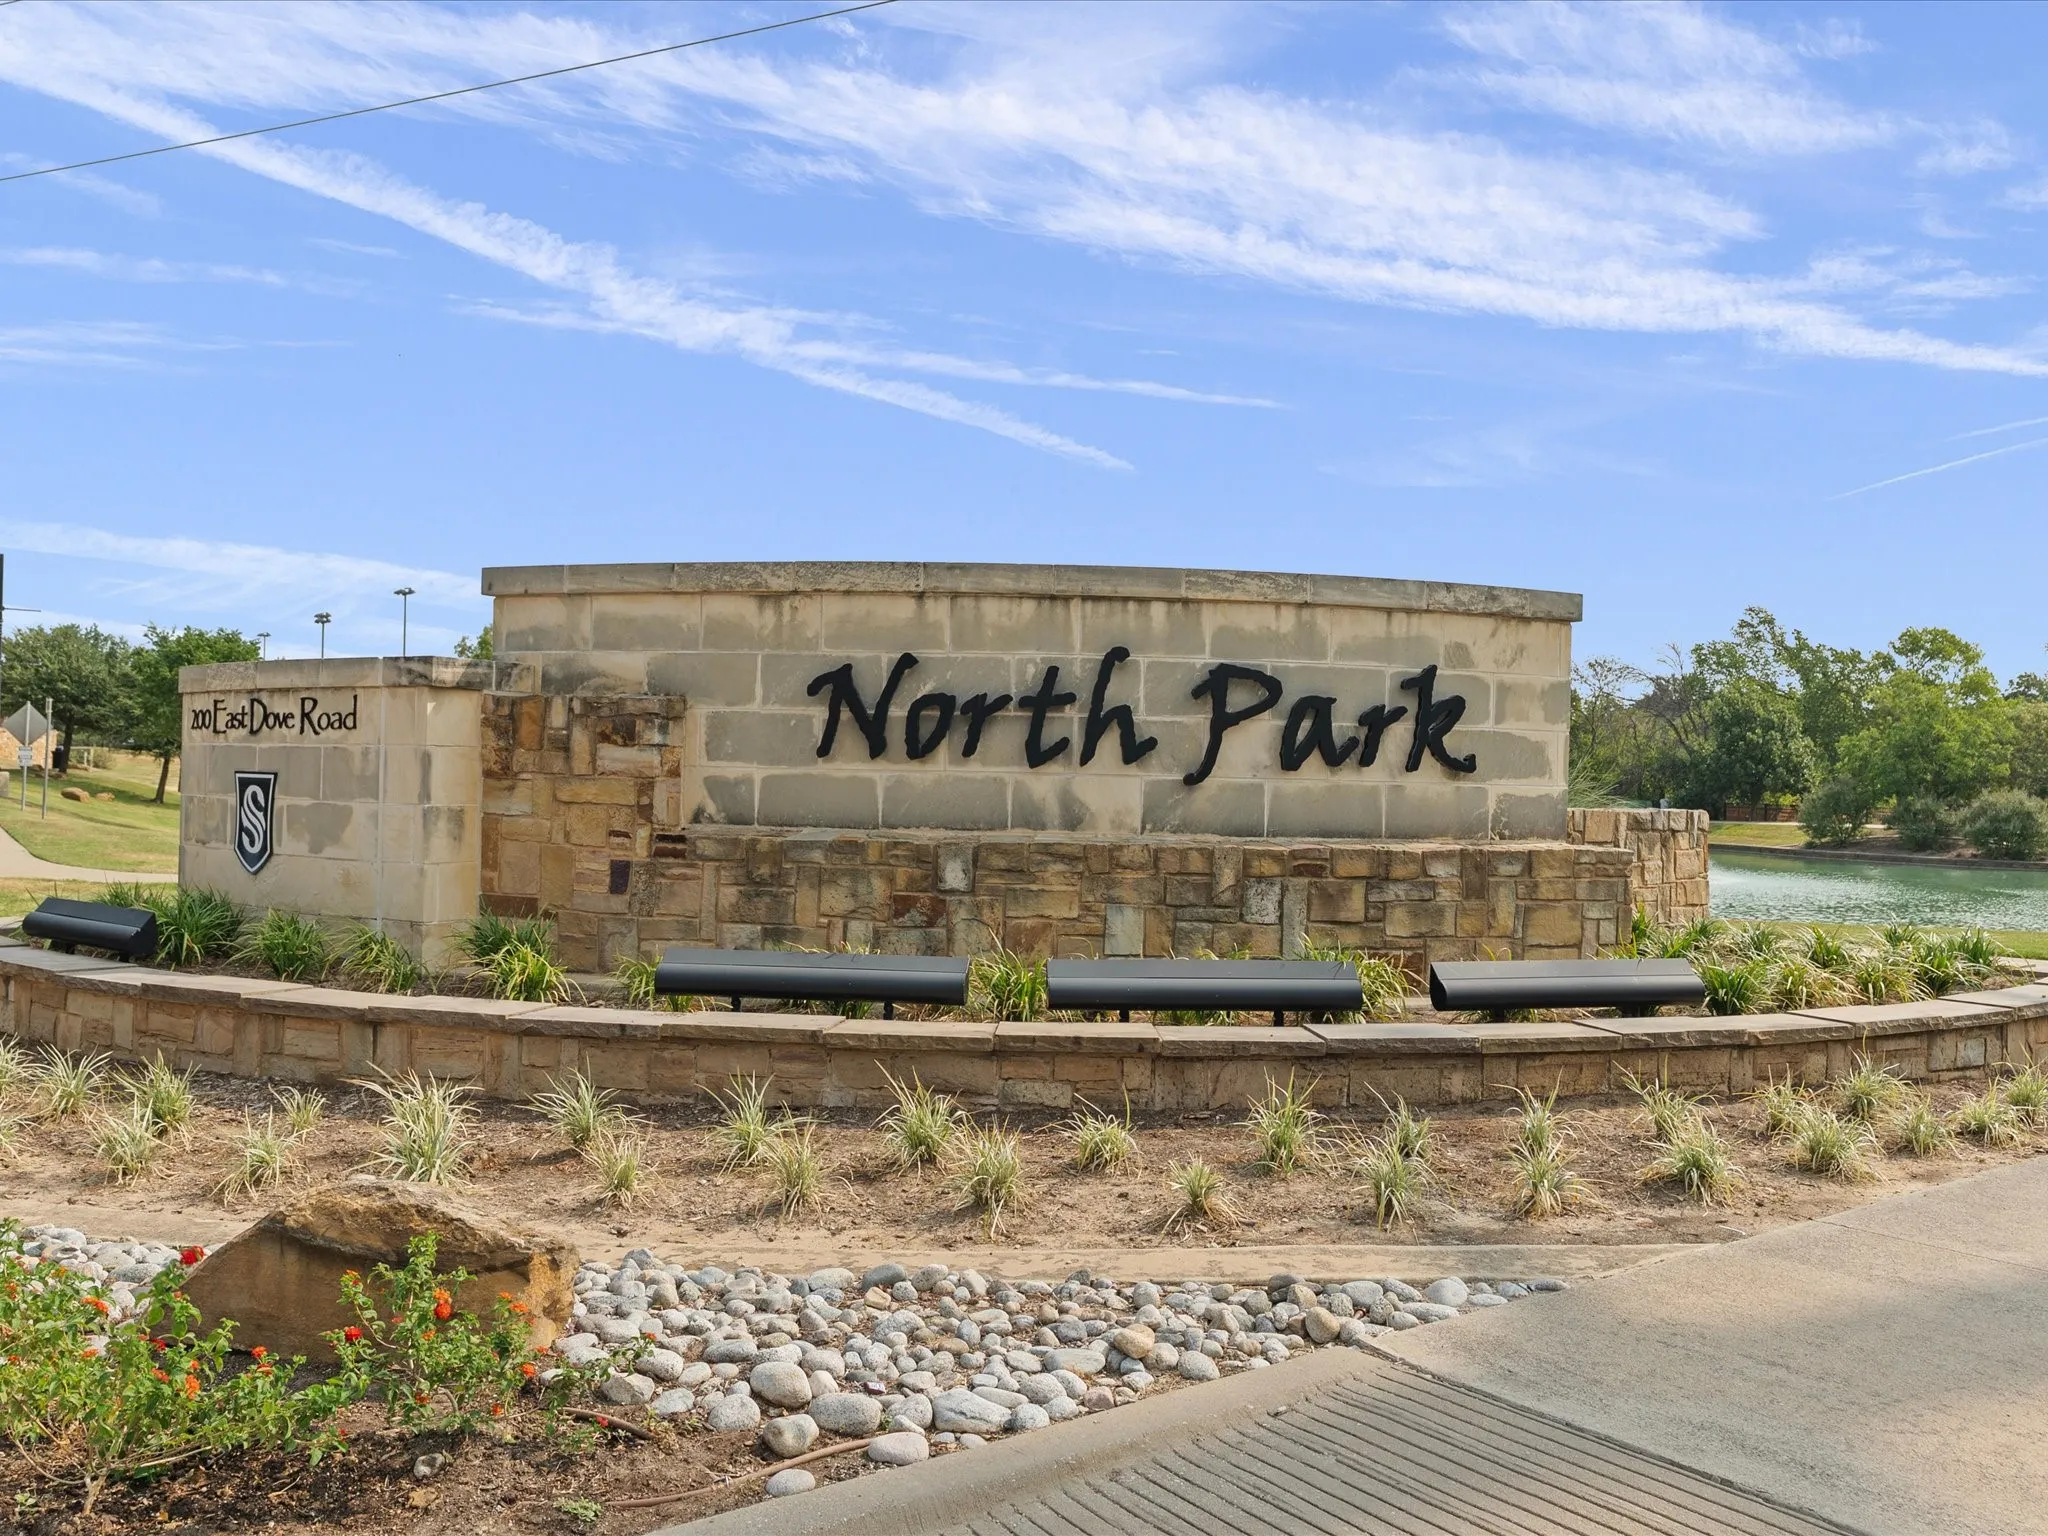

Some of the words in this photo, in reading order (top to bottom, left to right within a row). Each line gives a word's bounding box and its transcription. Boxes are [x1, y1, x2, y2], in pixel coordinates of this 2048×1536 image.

[191, 709, 212, 730] 200
[212, 699, 248, 734] East
[249, 697, 295, 736] Dove
[299, 694, 358, 736] Road
[806, 645, 1158, 768] North
[1182, 662, 1477, 786] Park
